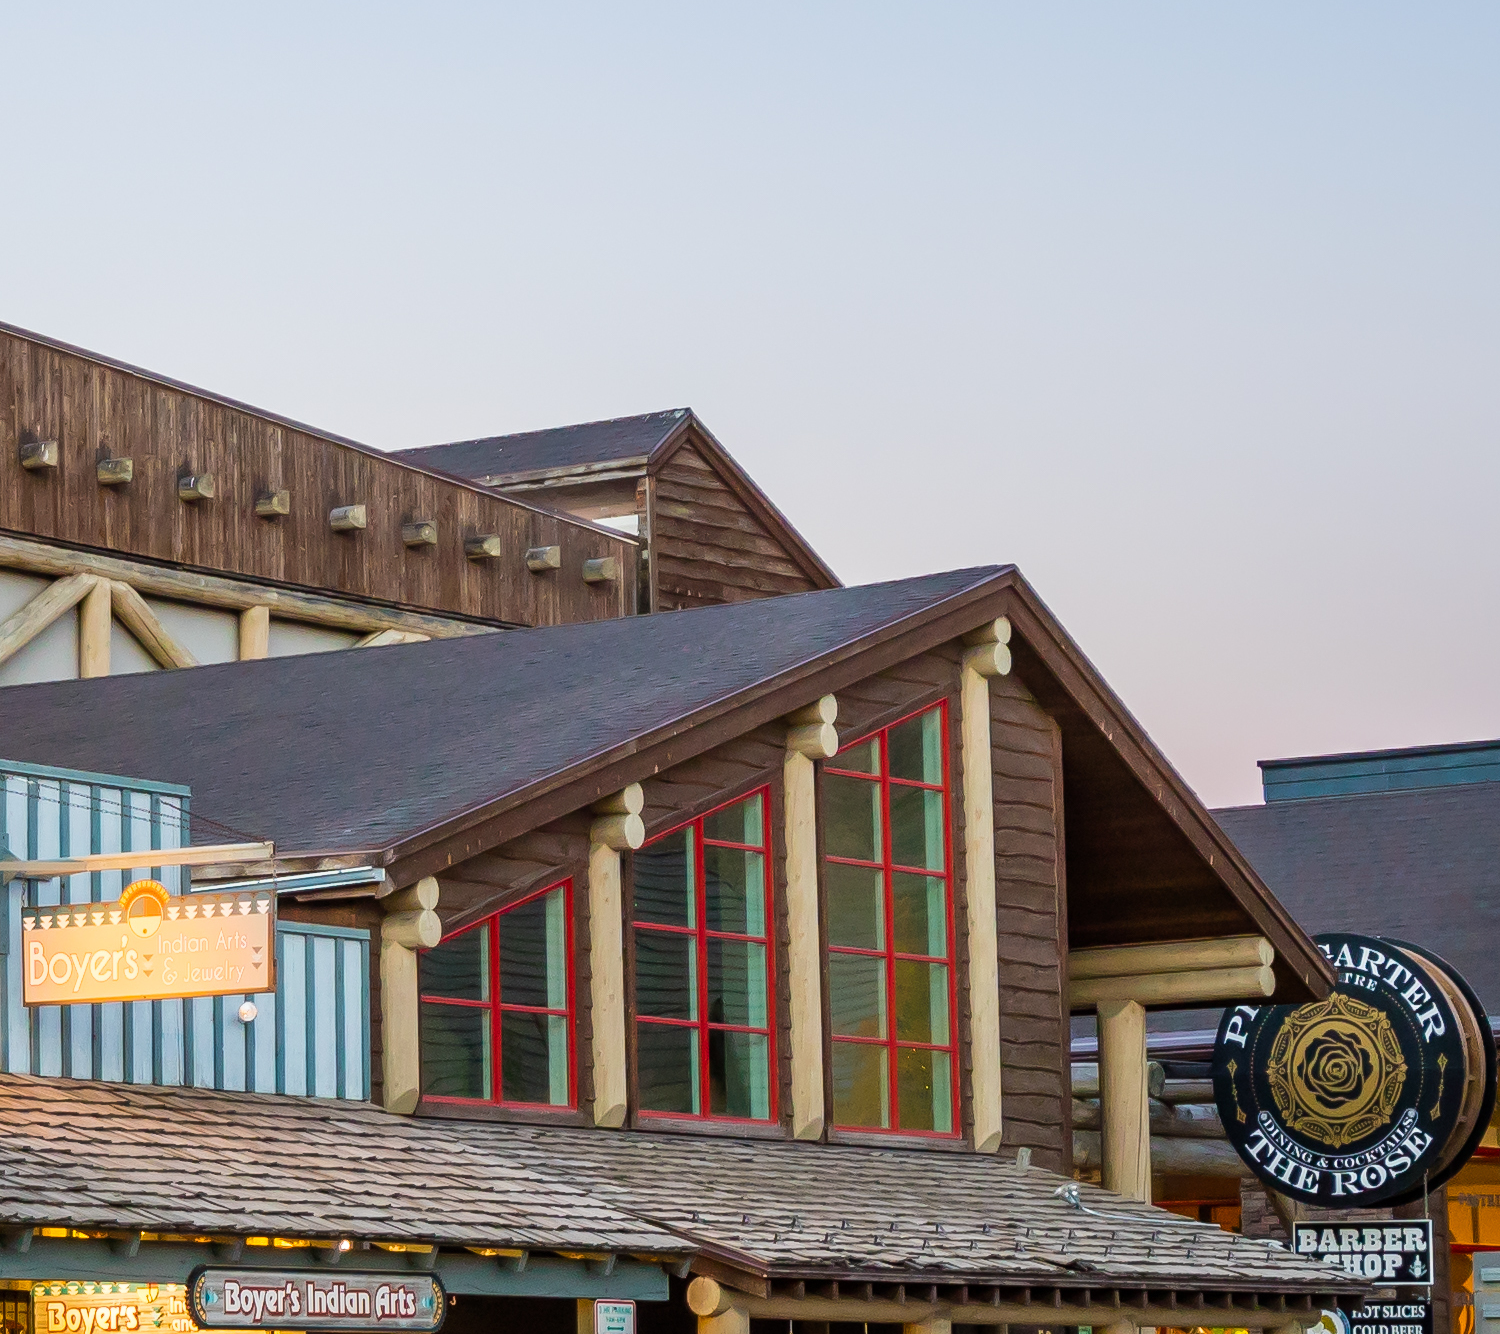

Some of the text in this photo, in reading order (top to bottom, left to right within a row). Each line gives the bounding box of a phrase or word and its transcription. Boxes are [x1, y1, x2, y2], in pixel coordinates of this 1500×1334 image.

[158, 928, 248, 955] Indian Arts
[29, 934, 139, 993] Boyer's
[162, 957, 245, 985] & Jewelry
[1262, 1116, 1415, 1169] DINING & COCKTAILS
[1245, 1127, 1434, 1196] THE ROSE
[1297, 1227, 1427, 1253] BARBER
[223, 1279, 301, 1324] Boyer's
[306, 1280, 372, 1319] Indian
[375, 1284, 416, 1322] Arts
[1382, 1305, 1426, 1318] SLICES
